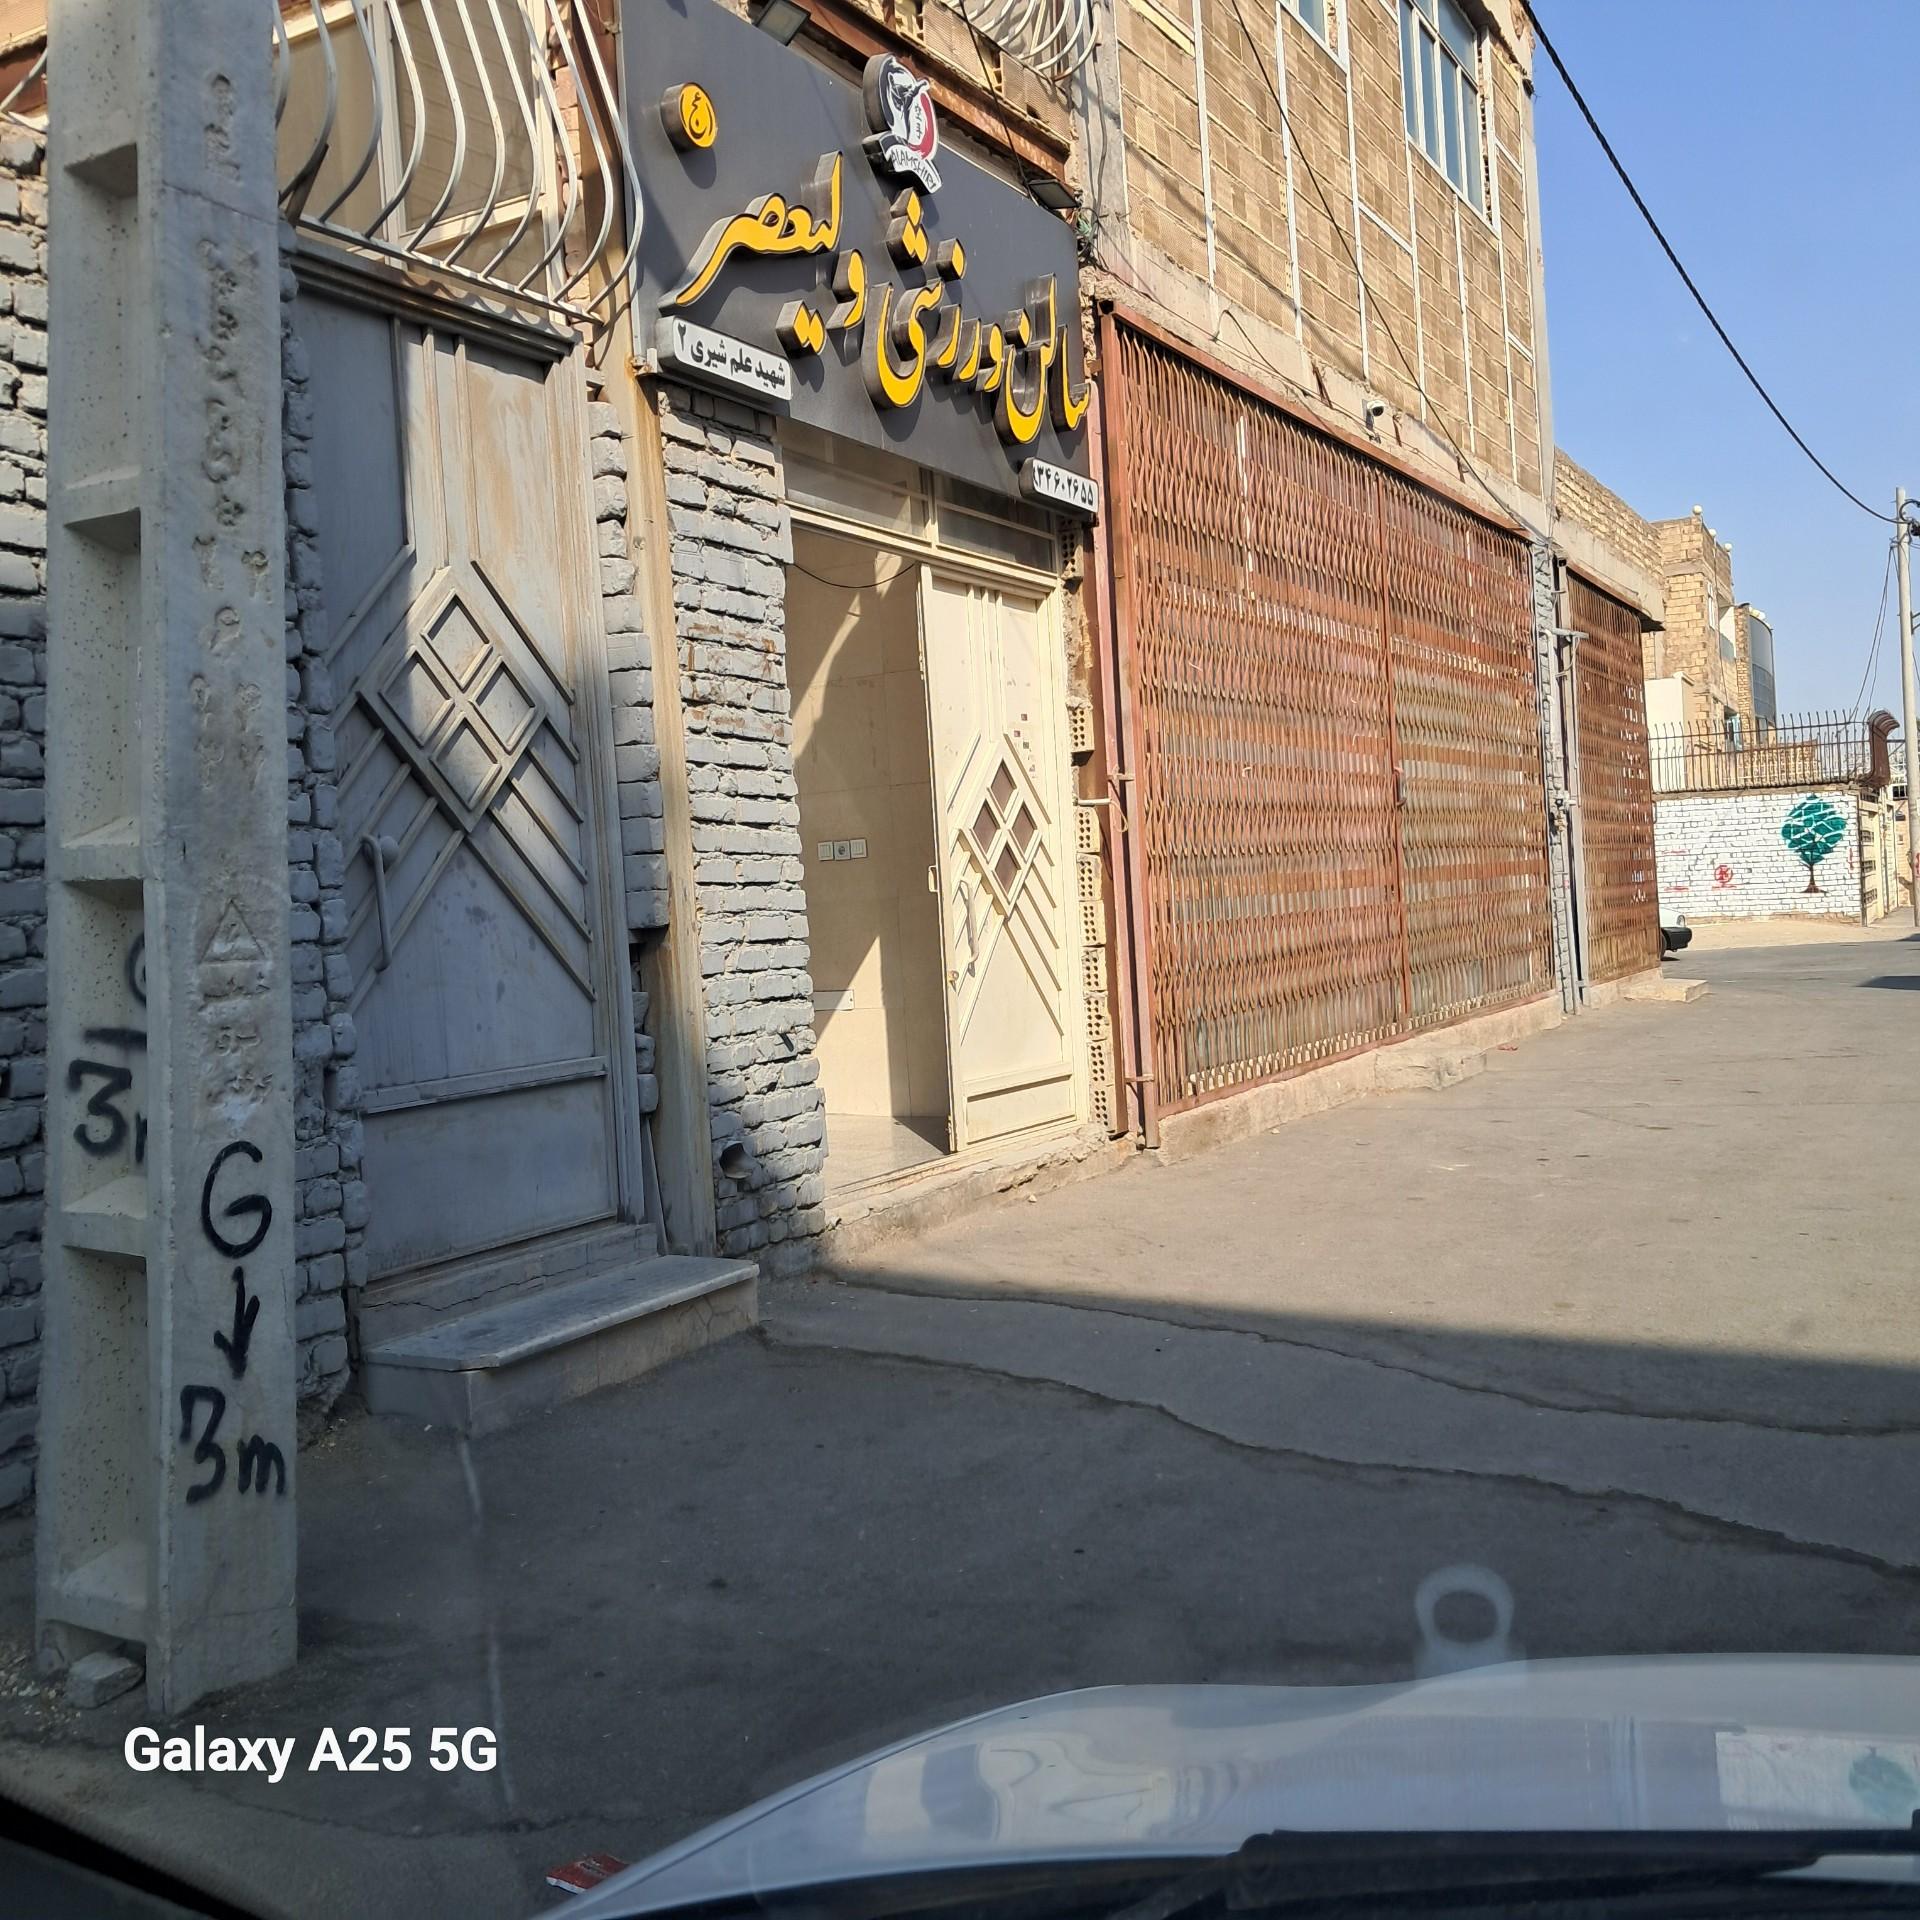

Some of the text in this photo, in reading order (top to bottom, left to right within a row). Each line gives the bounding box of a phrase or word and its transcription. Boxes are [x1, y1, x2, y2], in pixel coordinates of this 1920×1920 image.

[676, 150, 868, 355] ولیعصر
[876, 188, 1004, 408] ورزشی
[690, 339, 727, 369] شیری
[729, 347, 752, 376] علم
[754, 360, 786, 390] شهید
[1005, 273, 1091, 444] سالن
[201, 1141, 273, 1260] G
